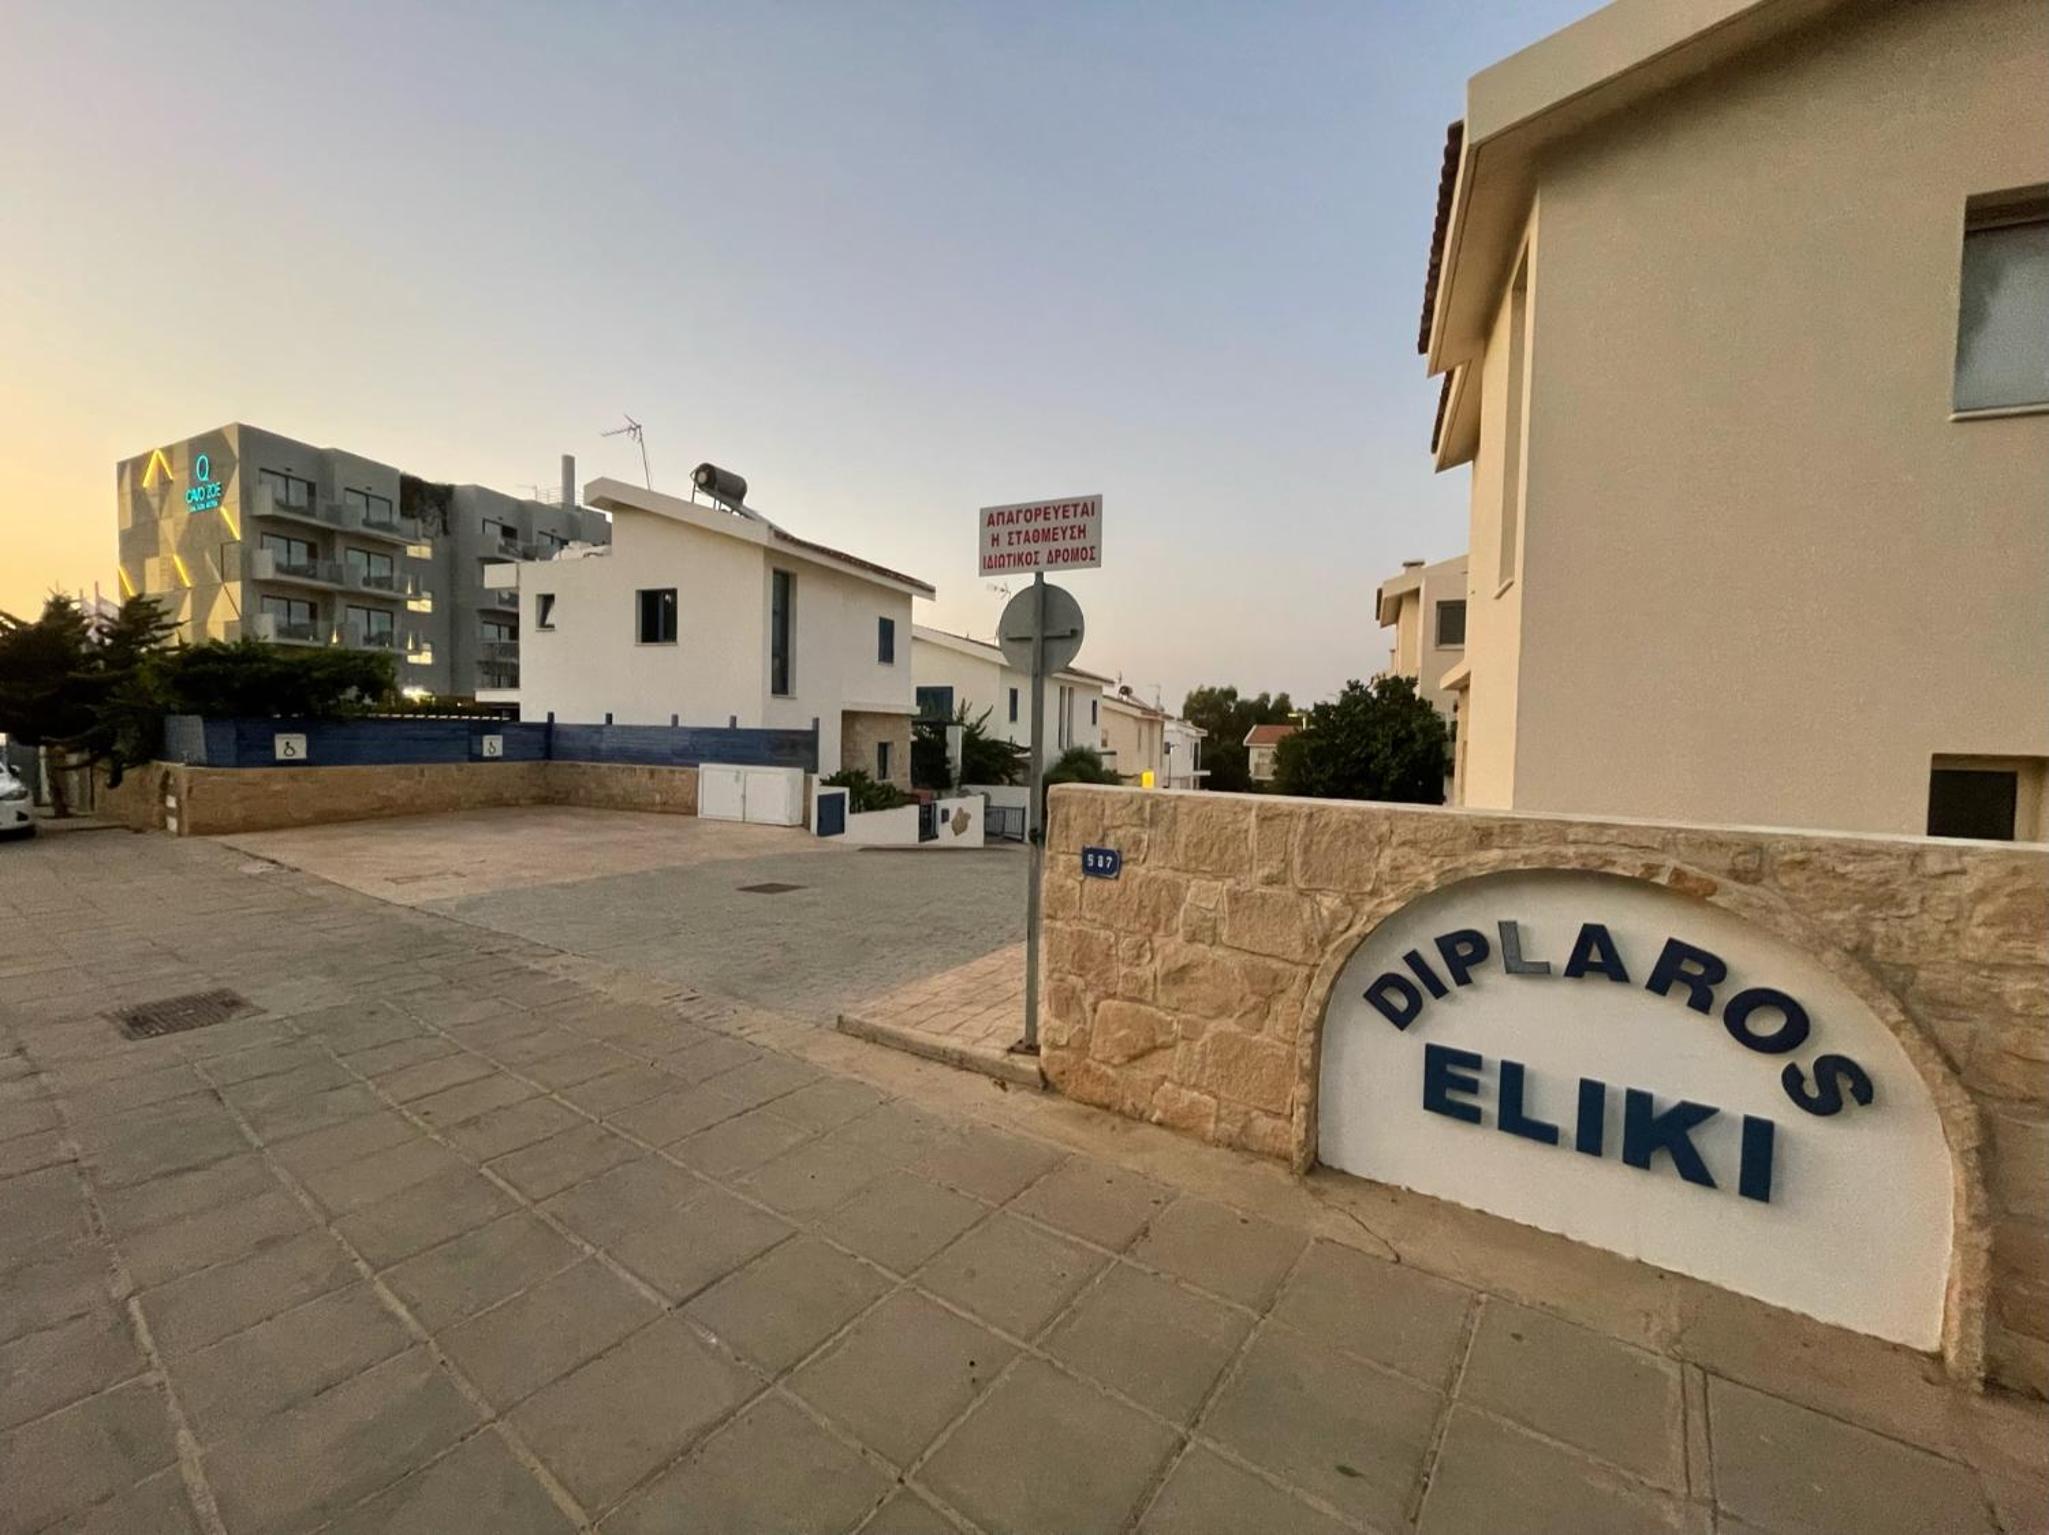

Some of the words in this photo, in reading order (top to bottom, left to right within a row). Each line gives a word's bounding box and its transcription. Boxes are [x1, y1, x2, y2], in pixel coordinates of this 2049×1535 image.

[987, 501, 1095, 527] ΑΠΑΓΟΡΕΥΕΤΑΙ
[991, 533, 999, 547] Η
[1007, 523, 1087, 546] ΣΤΑΘΜΕΥΣΗ
[983, 551, 1040, 569] ΙΔΙΩΤΙΚΟΣ
[1046, 546, 1096, 564] ΔΡΟΜΟΣ
[1363, 919, 1875, 1117] DIPLAROS
[1423, 1042, 1775, 1203] ELIKI
